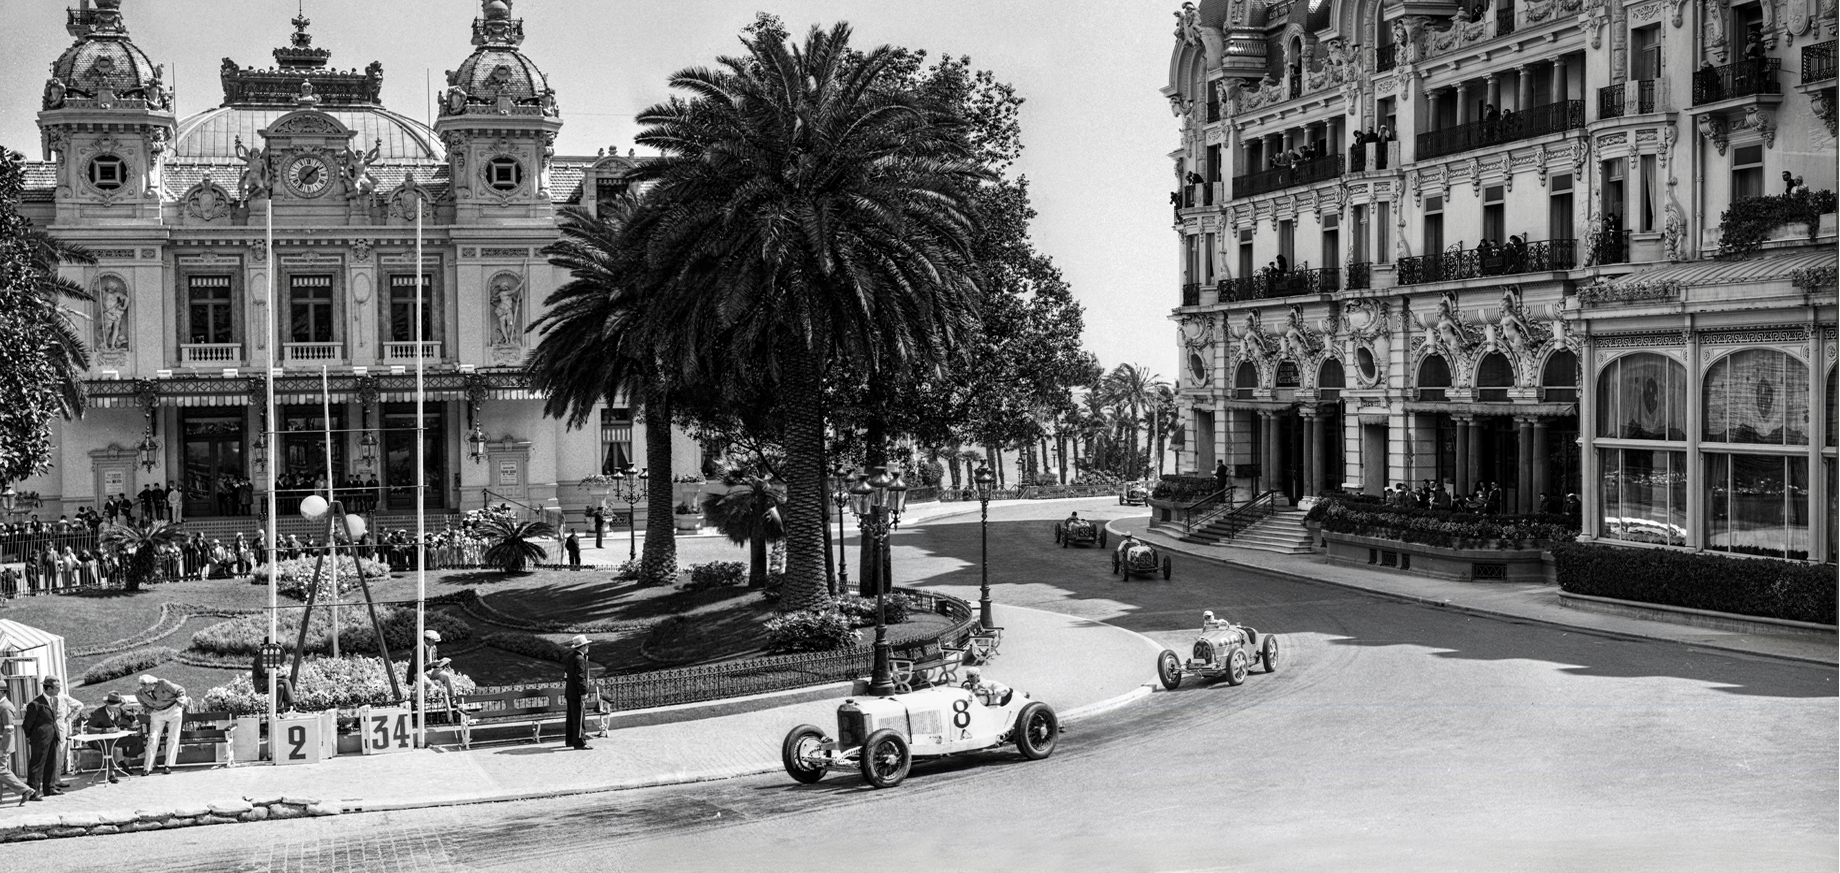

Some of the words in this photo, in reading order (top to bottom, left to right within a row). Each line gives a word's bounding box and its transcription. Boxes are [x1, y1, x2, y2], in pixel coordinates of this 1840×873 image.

[1194, 645, 1211, 660] 26
[952, 699, 971, 729] 8
[288, 725, 306, 760] 2
[371, 713, 410, 750] 34
